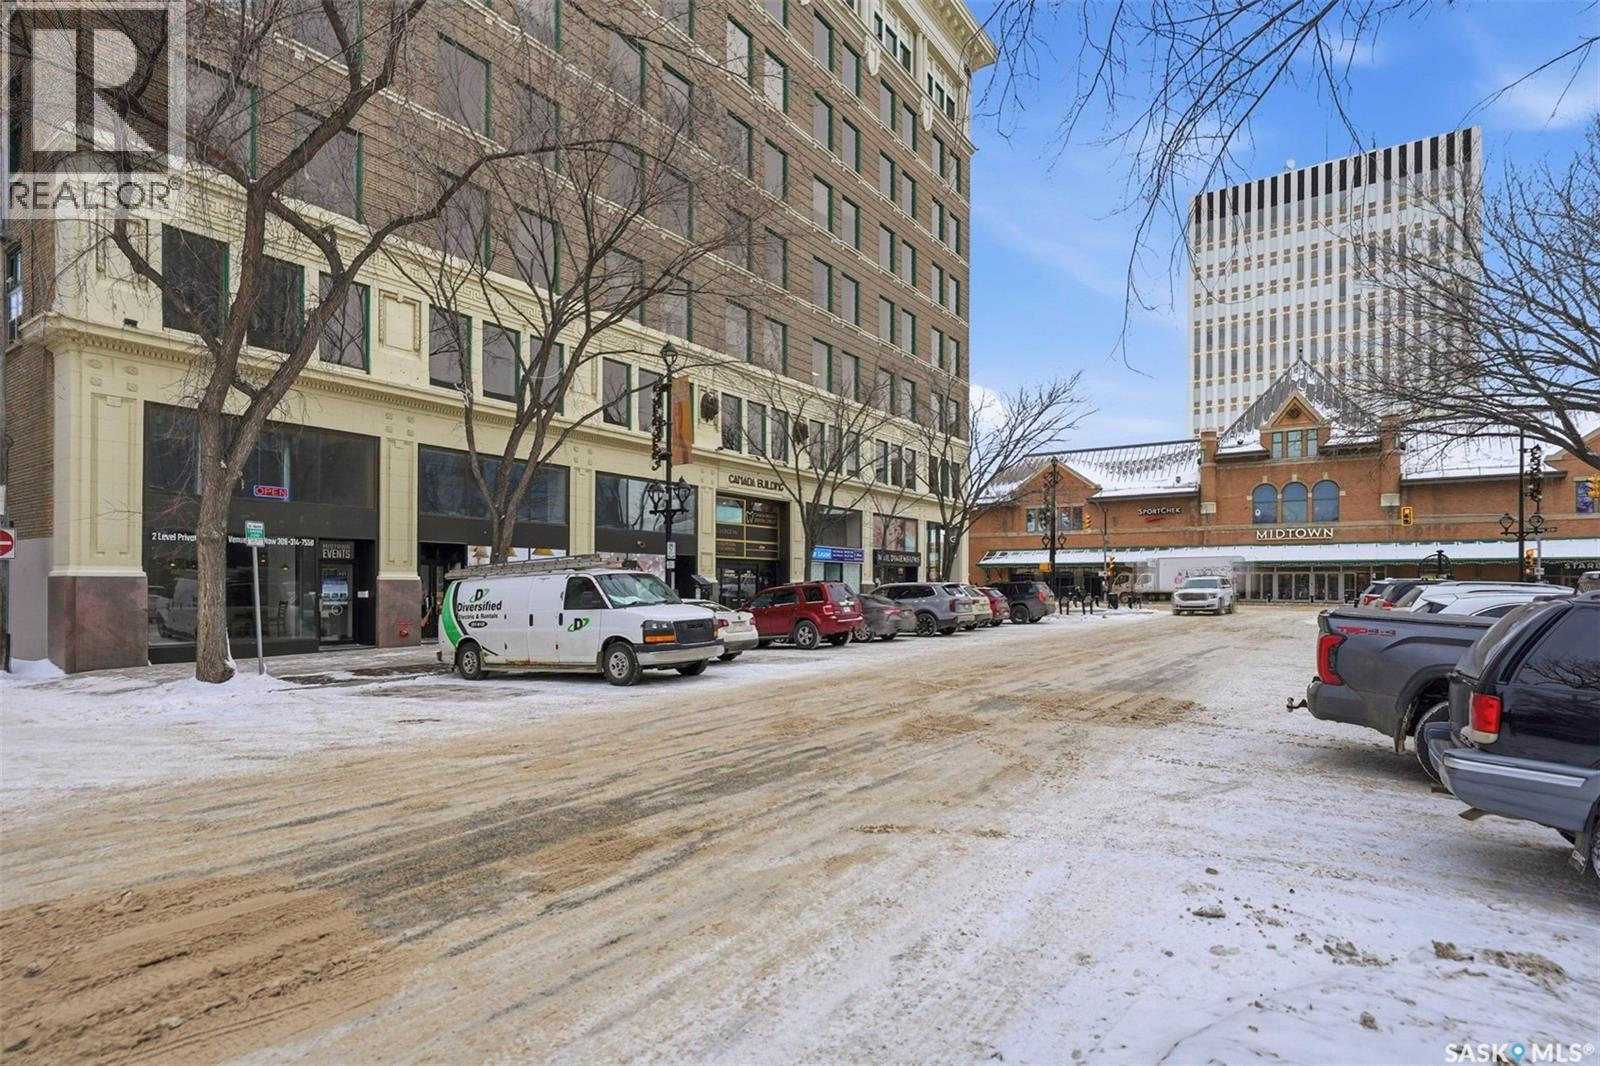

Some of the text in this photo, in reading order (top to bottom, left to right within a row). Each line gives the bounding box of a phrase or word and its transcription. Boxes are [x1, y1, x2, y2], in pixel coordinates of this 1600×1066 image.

[728, 474, 785, 491] CANADA BUILDING
[256, 487, 287, 497] OPEN
[157, 532, 177, 541] Level
[1256, 527, 1335, 540] MIDTOWN
[322, 549, 351, 559] EVENTS
[457, 600, 503, 613] Diversified
